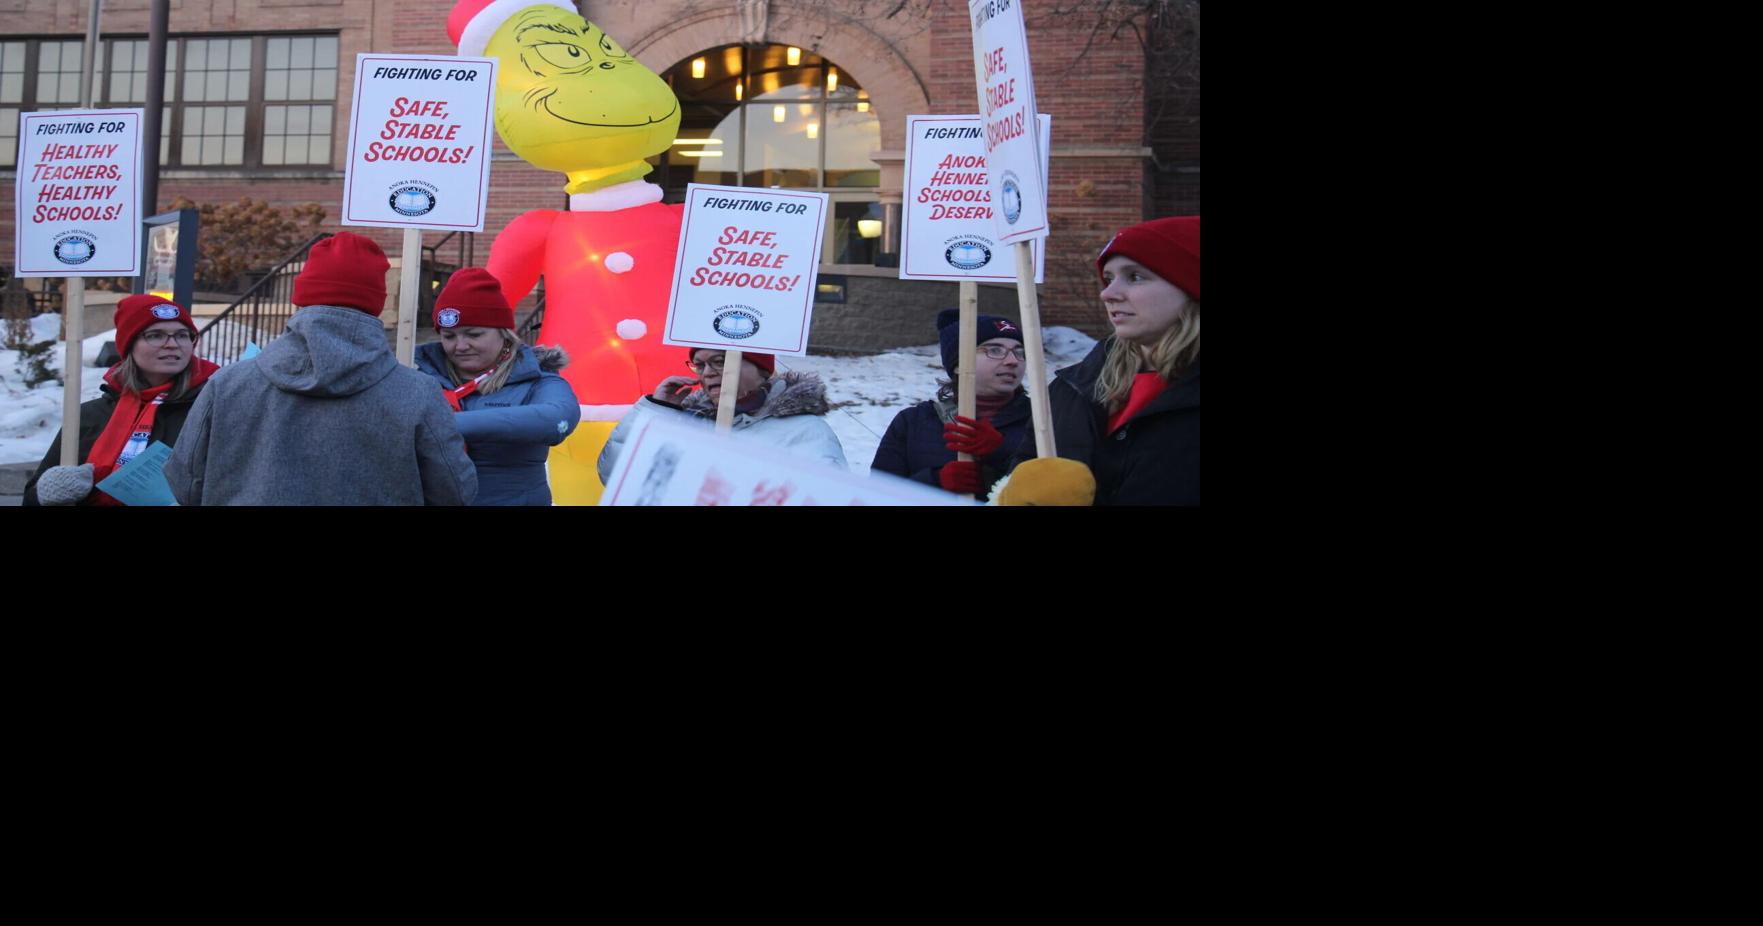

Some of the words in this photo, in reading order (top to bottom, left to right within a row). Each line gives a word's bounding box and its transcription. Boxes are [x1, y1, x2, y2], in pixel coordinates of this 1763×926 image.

[373, 67, 442, 80] FIGHTING
[445, 69, 478, 82] FOR
[984, 46, 1007, 83] SAFE,
[986, 78, 1015, 117] STABLE
[390, 97, 449, 120] SAFE,
[36, 122, 95, 135] FIGHTING
[98, 121, 126, 134] FOR
[380, 119, 461, 140] STABLE
[924, 127, 983, 139] FIGHTIN
[987, 105, 1025, 153] SCHOOLS!
[41, 143, 119, 162] HEALTHY
[364, 141, 474, 164] SCHOOLS!
[938, 153, 986, 170] ANOK
[31, 163, 123, 183] TEACHERS,
[930, 171, 988, 187] HENNE
[37, 184, 117, 203] HEALTHY
[392, 186, 434, 198] EDUCATION
[33, 203, 123, 224] SCHOOLS!
[703, 197, 773, 212] FIGHTING
[776, 202, 808, 216] FOR
[929, 203, 993, 220] DESERV
[718, 225, 778, 249] SAFE,
[708, 247, 789, 269] STABLE
[690, 267, 800, 292] SCHOOLS!
